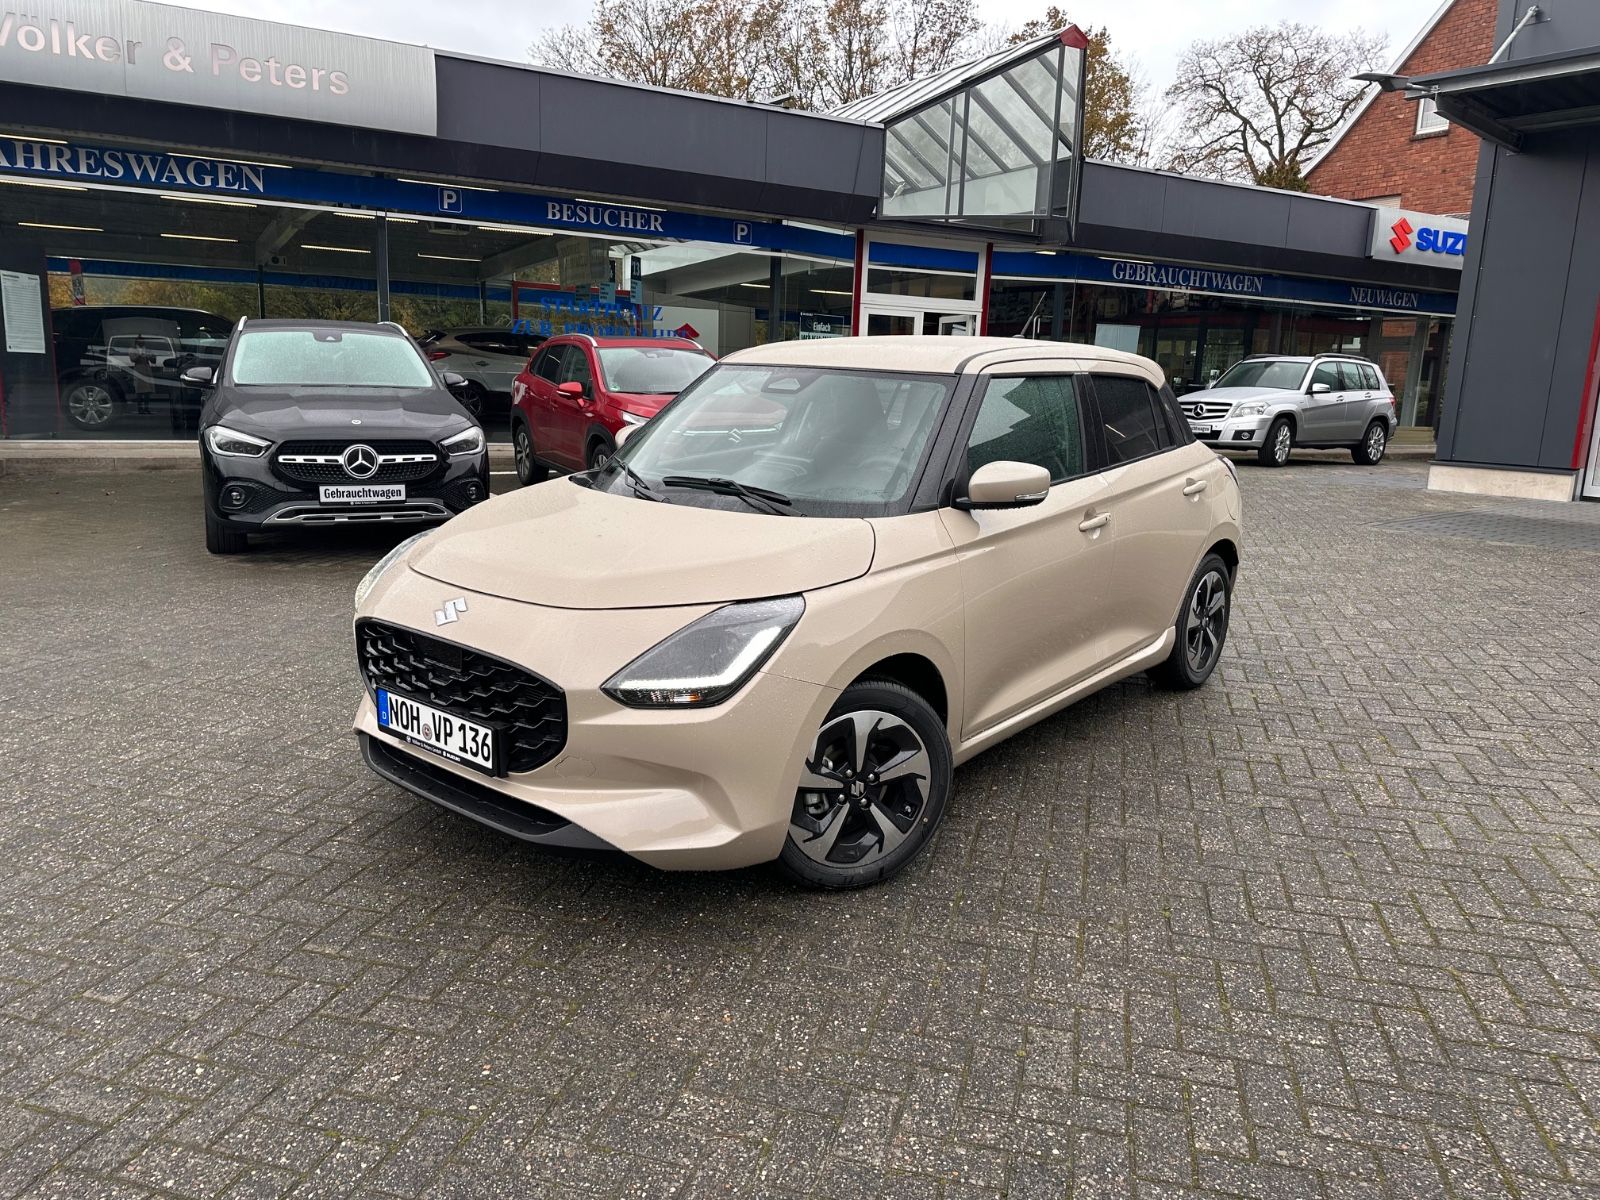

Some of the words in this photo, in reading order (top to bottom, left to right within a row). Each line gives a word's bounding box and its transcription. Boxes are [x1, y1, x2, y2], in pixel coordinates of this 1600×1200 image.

[0, 11, 142, 65] Völker
[162, 37, 195, 73] &
[210, 43, 350, 96] Peters
[443, 190, 457, 209] P
[546, 201, 664, 232] BESUCHER
[736, 223, 748, 241] P
[1112, 261, 1264, 293] GEBRAUCHTWAGEN
[1349, 286, 1418, 308] NEUWAGEN
[324, 487, 402, 500] Gebrauchtwagen
[389, 696, 421, 735] NOH
[432, 712, 454, 746] VP
[458, 723, 490, 762] 136
